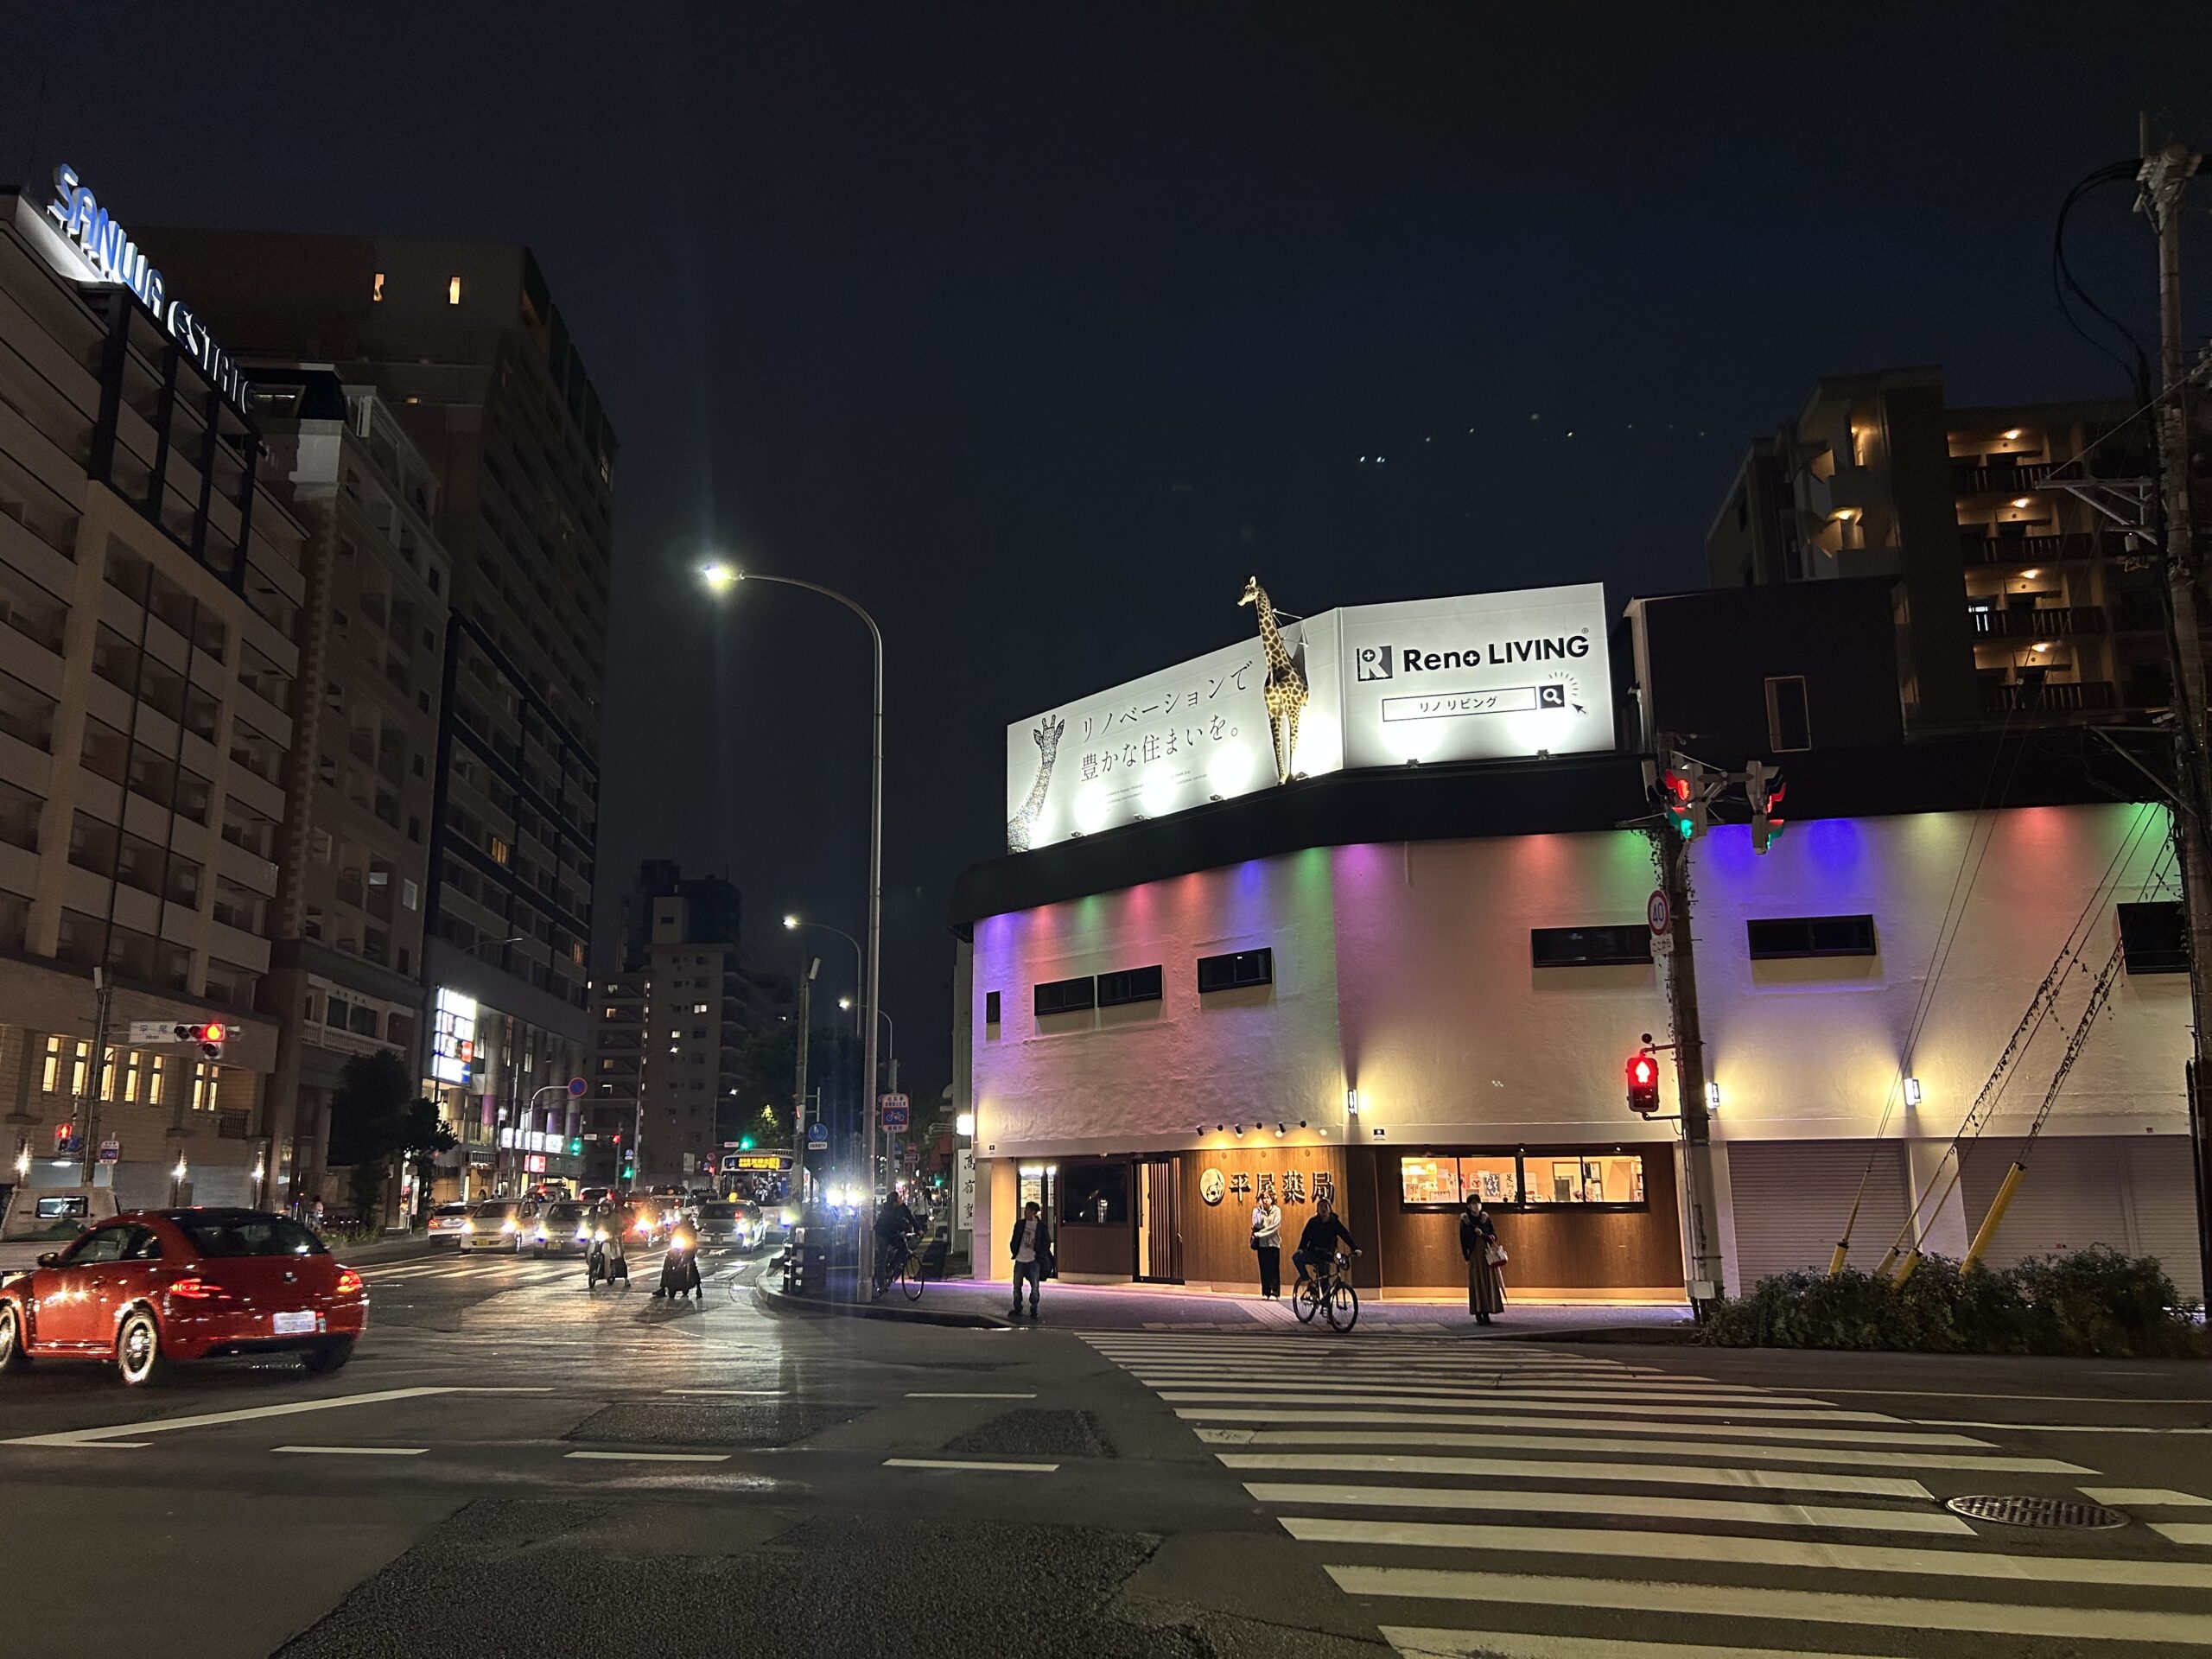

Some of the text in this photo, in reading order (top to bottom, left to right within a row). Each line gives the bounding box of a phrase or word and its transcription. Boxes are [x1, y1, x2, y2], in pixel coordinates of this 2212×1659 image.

[53, 162, 165, 321] SANWA
[1403, 635, 1590, 672] Reno LIVING
[1084, 659, 1253, 744] リノベーションで
[1080, 714, 1238, 782] 豊かな住まいを。
[1652, 902, 1664, 923] 40
